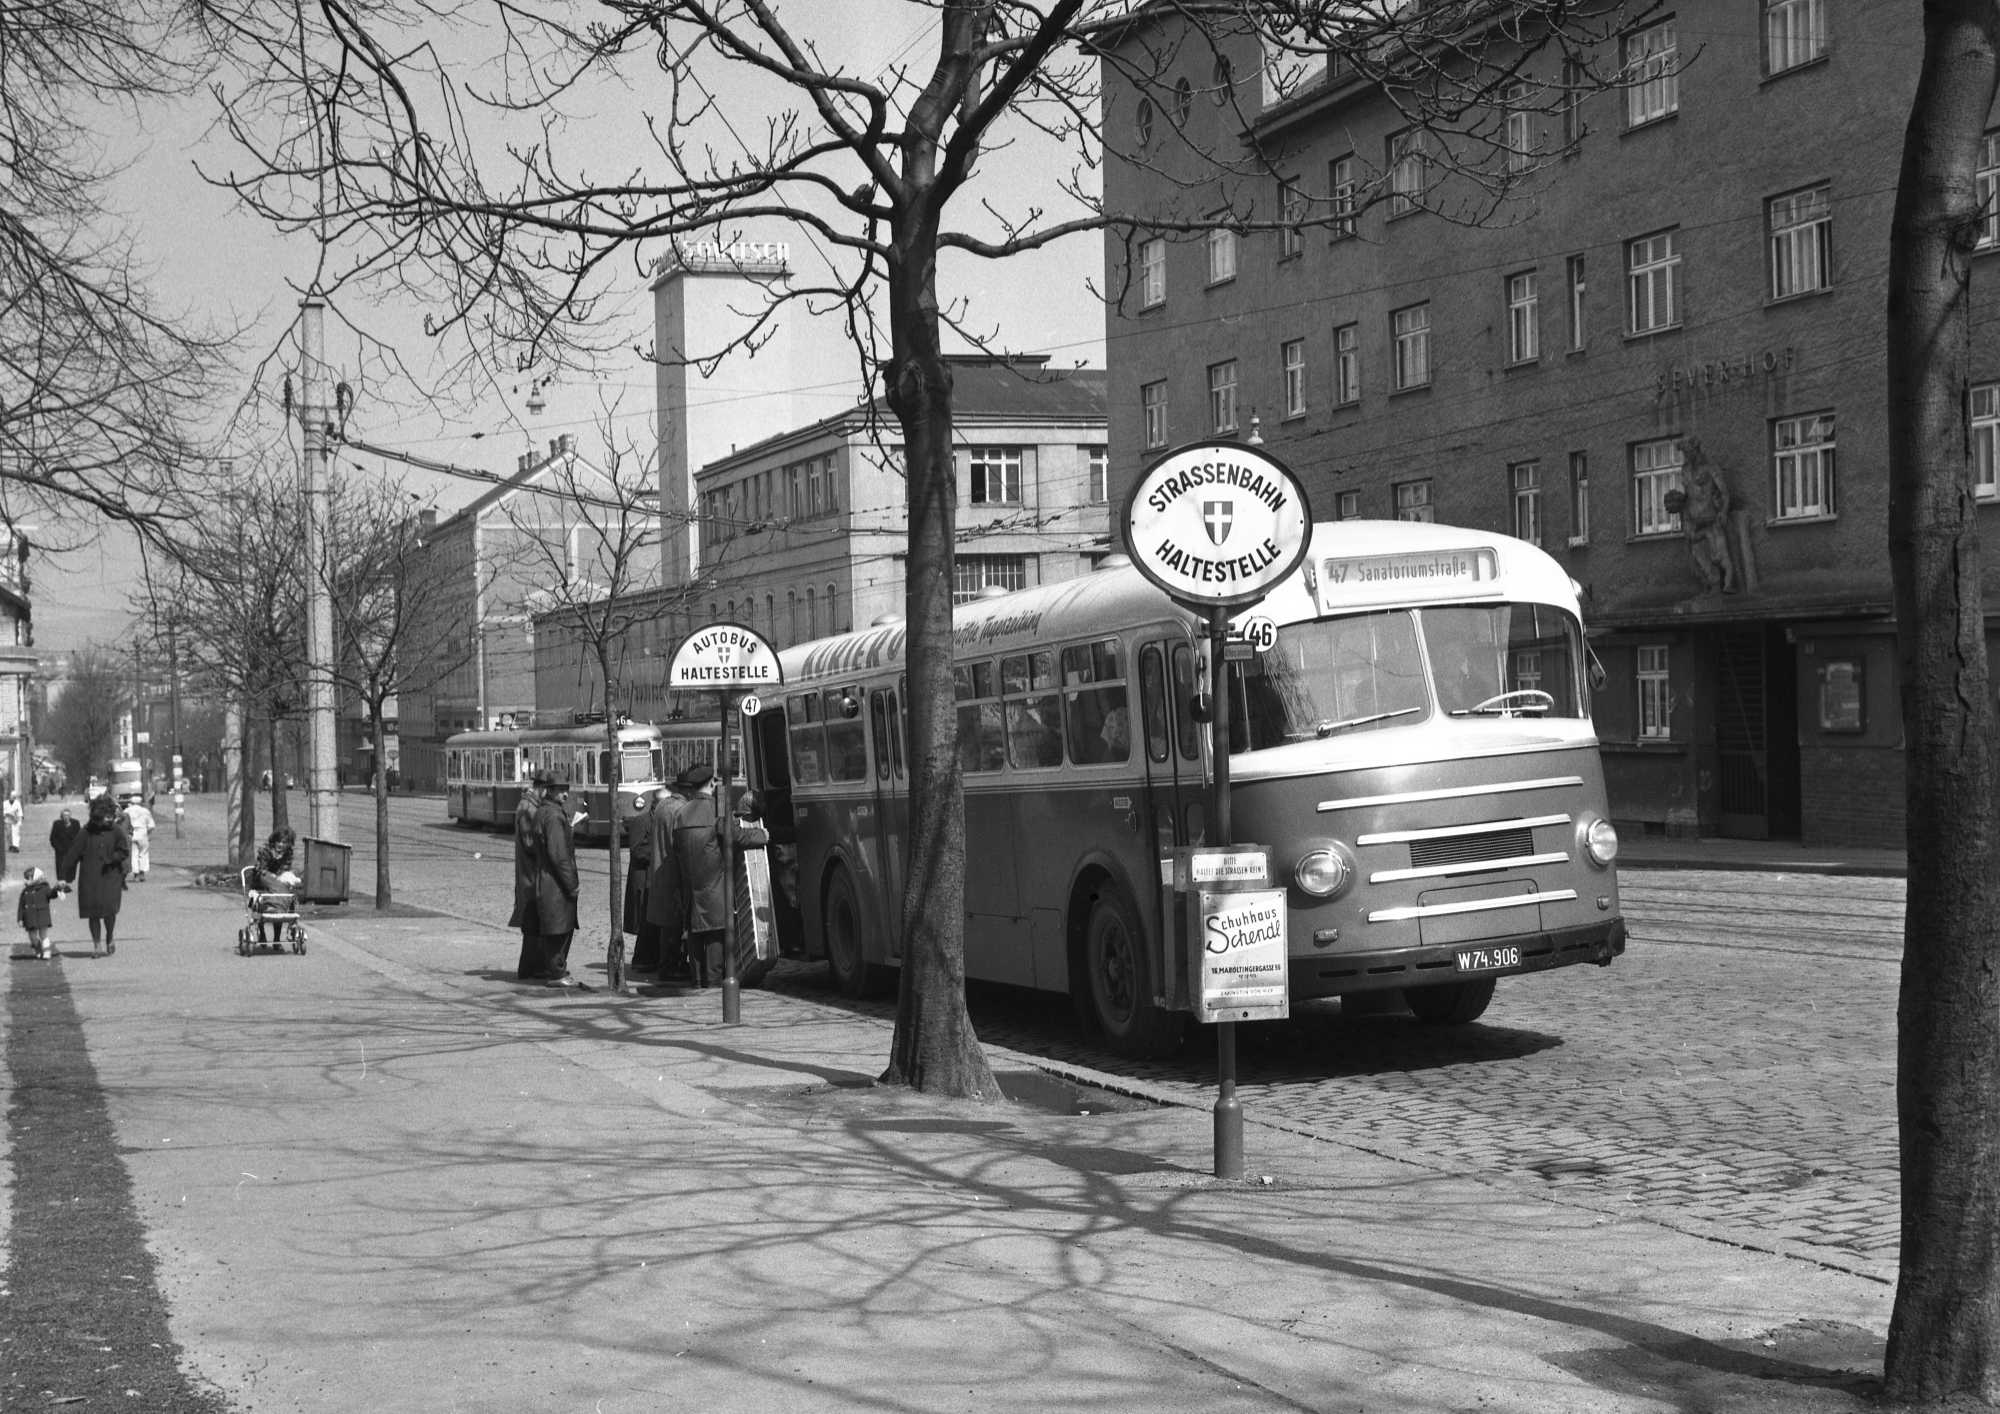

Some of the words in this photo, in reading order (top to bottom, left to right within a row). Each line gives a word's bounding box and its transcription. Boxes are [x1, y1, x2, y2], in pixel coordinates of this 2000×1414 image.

[683, 240, 790, 261] SOWITSCH
[1148, 462, 1287, 513] STRASSENBAHN
[1155, 537, 1282, 583] HALTESTELLE
[1328, 563, 1349, 584] 47
[1357, 555, 1466, 583] Sanatoriumstraße
[692, 631, 757, 655] AUTOBUS
[1248, 622, 1272, 647] 46
[800, 627, 894, 682] KURIER
[681, 665, 769, 680] HALTESTELLE
[744, 698, 758, 713] 47
[1215, 867, 1224, 876] DIE
[1225, 866, 1248, 875] STRASSEN
[1223, 856, 1237, 866] BITTE
[1206, 916, 1281, 954] Schendl
[1458, 952, 1471, 970] W
[1473, 947, 1518, 969] 74.906
